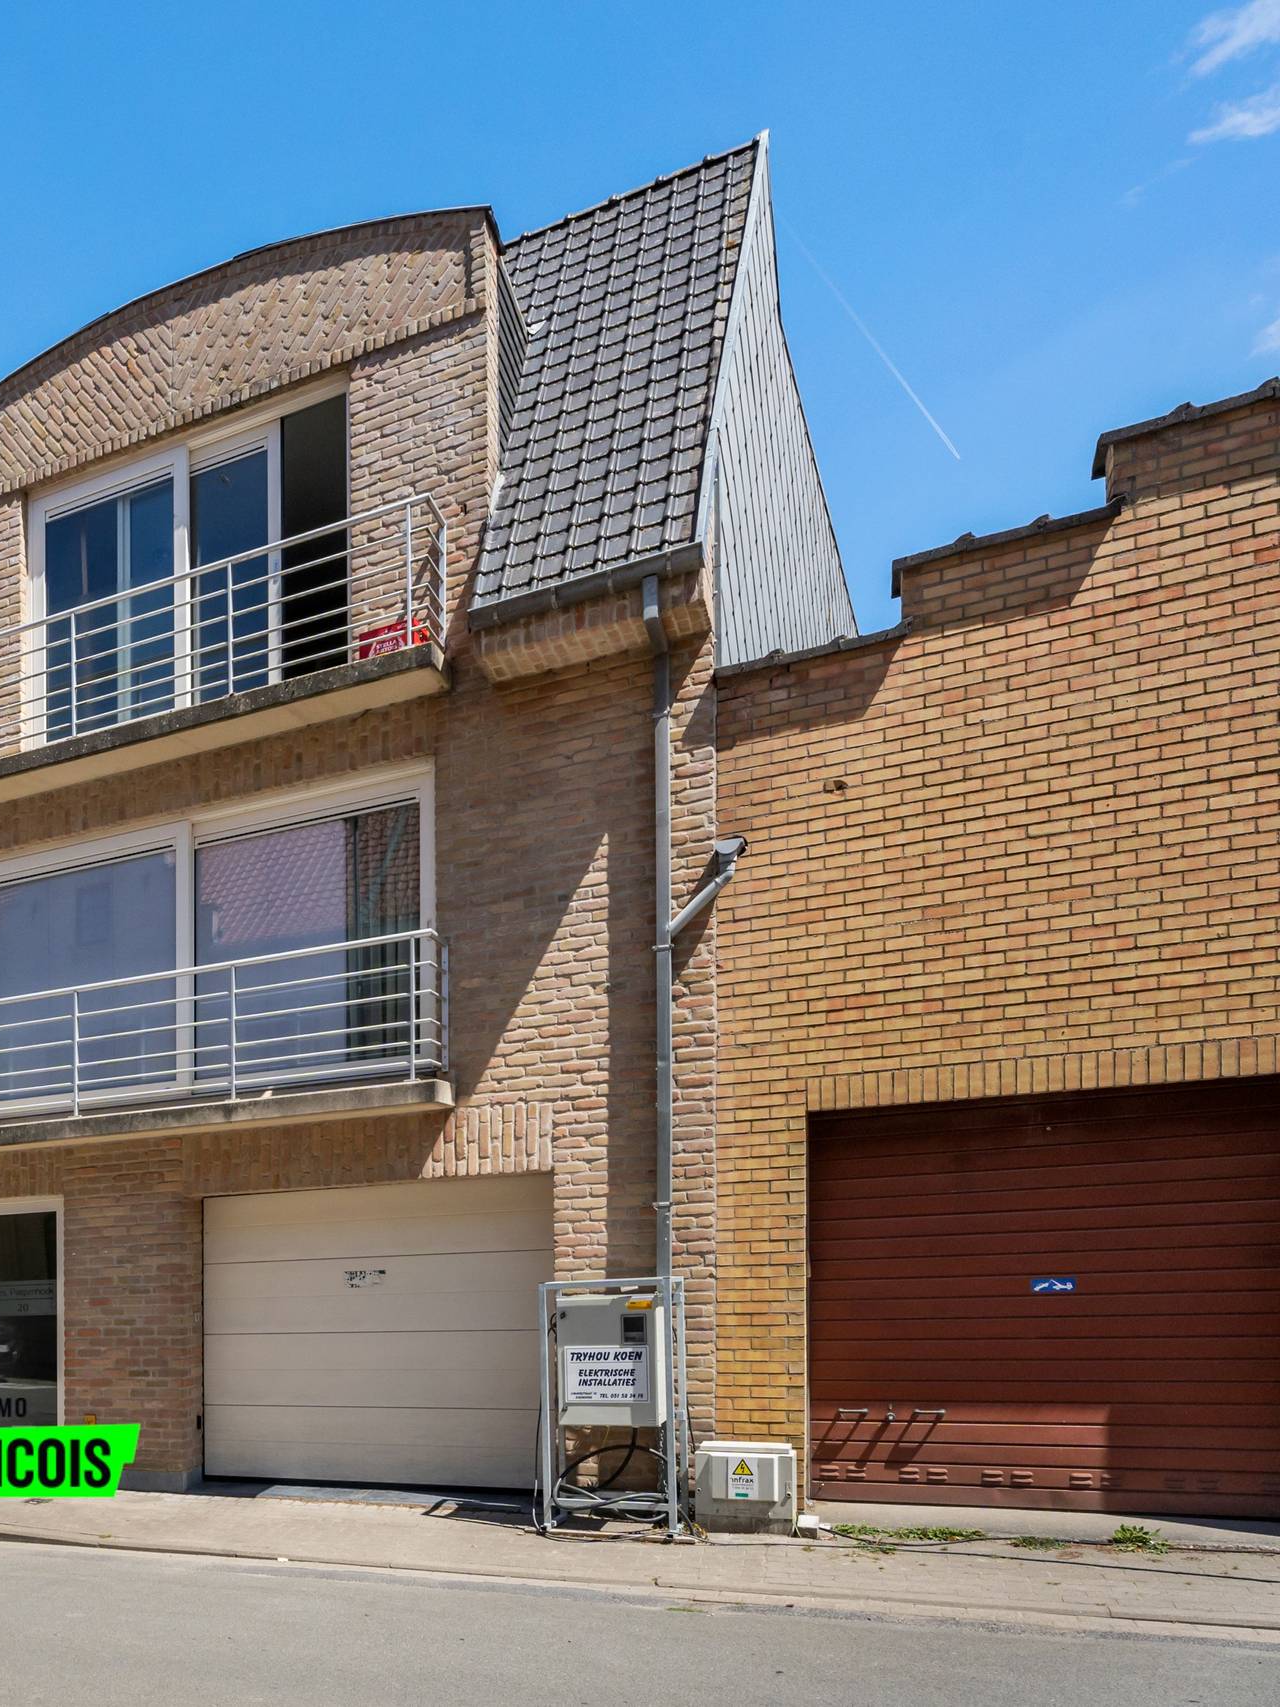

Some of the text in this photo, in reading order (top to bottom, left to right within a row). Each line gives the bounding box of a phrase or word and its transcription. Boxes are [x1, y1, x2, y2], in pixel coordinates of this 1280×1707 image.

[376, 639, 397, 650] STELLA
[17, 1303, 29, 1313] 20
[570, 1351, 643, 1361] TRYHOU KOEN
[578, 1368, 636, 1377] ELEKTRISCHE
[578, 1378, 636, 1387] INSTALLATIES
[730, 1476, 754, 1484] infrax
